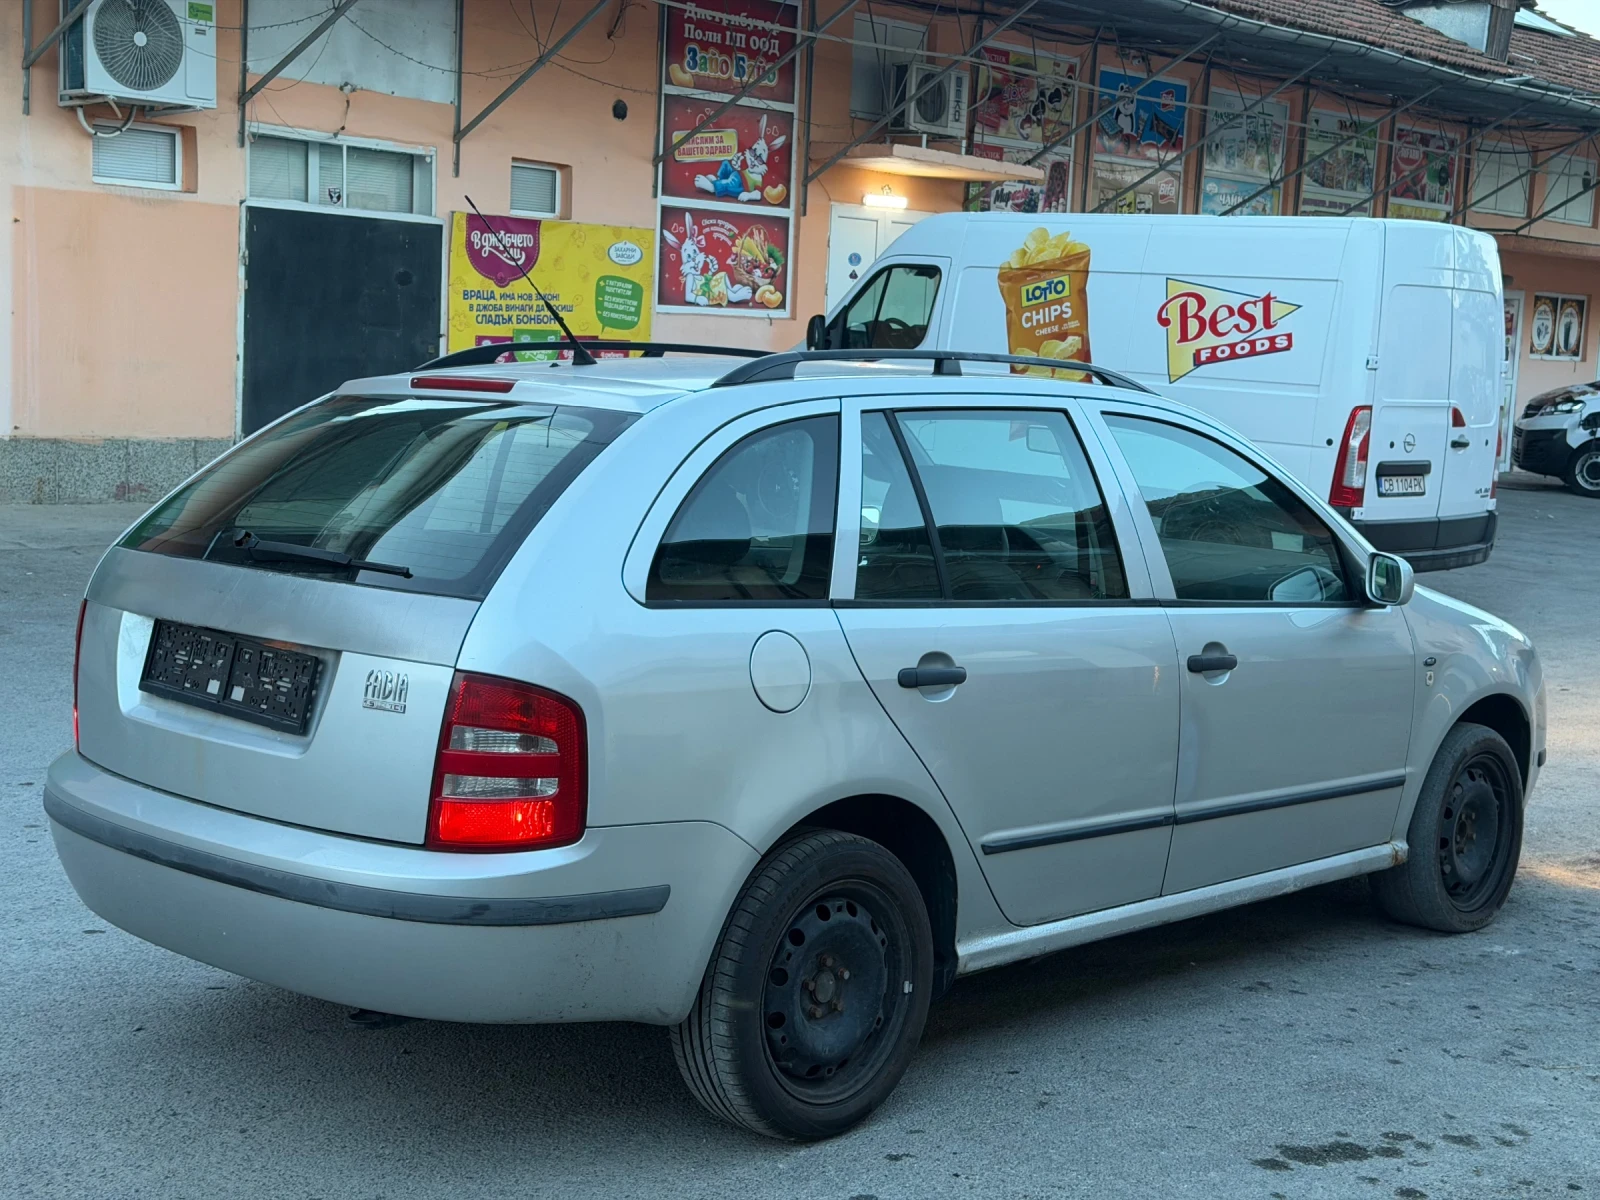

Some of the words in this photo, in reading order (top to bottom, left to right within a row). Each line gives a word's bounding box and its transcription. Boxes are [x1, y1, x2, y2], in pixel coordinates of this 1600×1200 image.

[677, 146, 704, 157] ВАШЕТО
[1159, 183, 1175, 196] Bifa
[462, 289, 498, 302] ВРАЦА,
[499, 293, 516, 301] ИМА
[517, 293, 533, 301] НОВ
[534, 293, 560, 301] ЗАКОН!
[1025, 279, 1066, 302] LOTTO
[468, 304, 474, 312] В
[475, 303, 503, 313] ДЖОБА
[505, 303, 534, 312] ВИНАГИ
[535, 304, 545, 313] ДА
[547, 304, 574, 312] ОСИШ
[1021, 301, 1072, 328] CHIPS
[475, 314, 514, 326] СЛАДЪК
[515, 314, 557, 325] БОНБОН
[1157, 291, 1278, 344] Best
[1034, 324, 1060, 336] CHEESE
[1200, 335, 1289, 361] FOODS
[1396, 478, 1413, 491] 1104
[363, 668, 409, 703] FABIA
